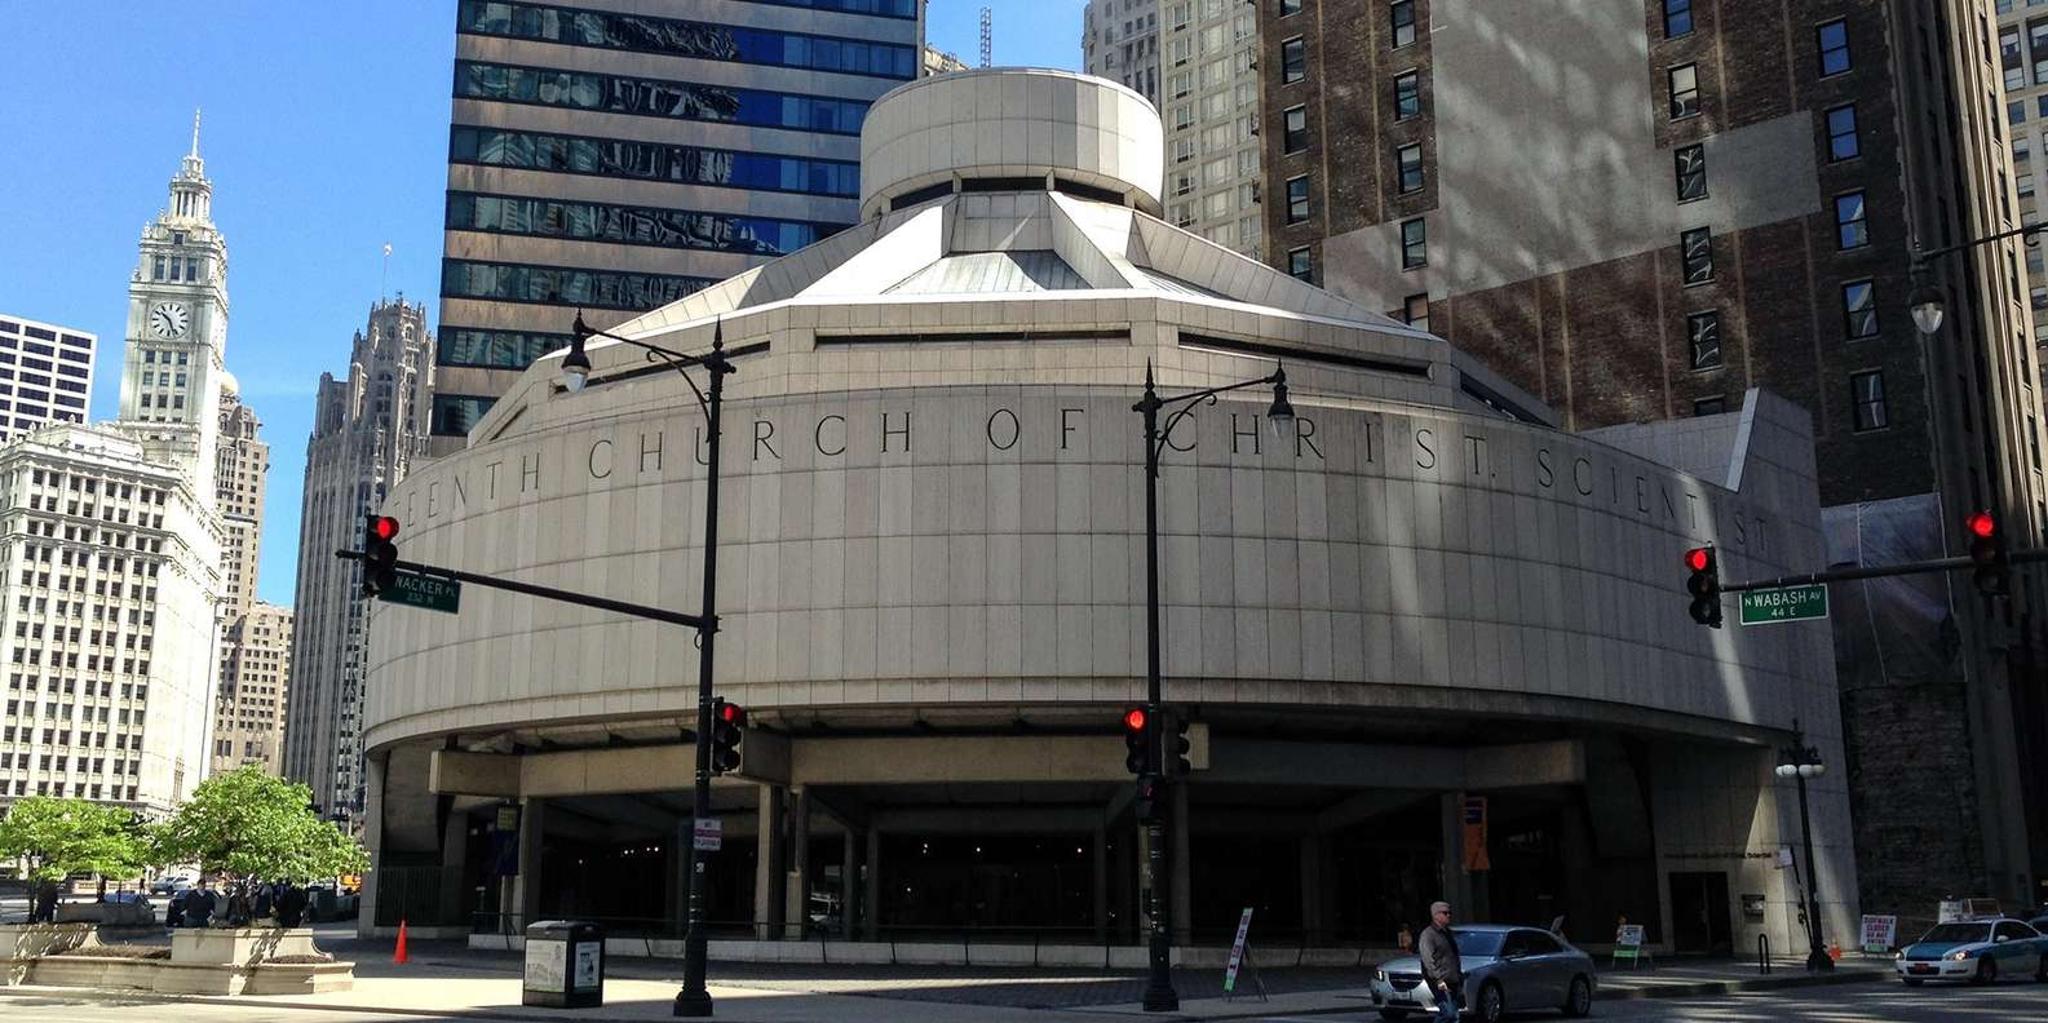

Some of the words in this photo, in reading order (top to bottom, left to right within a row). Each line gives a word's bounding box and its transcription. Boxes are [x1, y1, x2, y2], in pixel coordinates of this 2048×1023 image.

[394, 452, 541, 528] EENTH
[588, 411, 912, 480] CHURCH
[987, 408, 1084, 450] OF
[1537, 448, 1768, 552] SCIENTIST
[1744, 598, 1752, 607] N
[1753, 591, 1807, 607] WABASH
[1808, 591, 1821, 601] AV
[1771, 608, 1785, 617] 44
[1789, 606, 1796, 616] E
